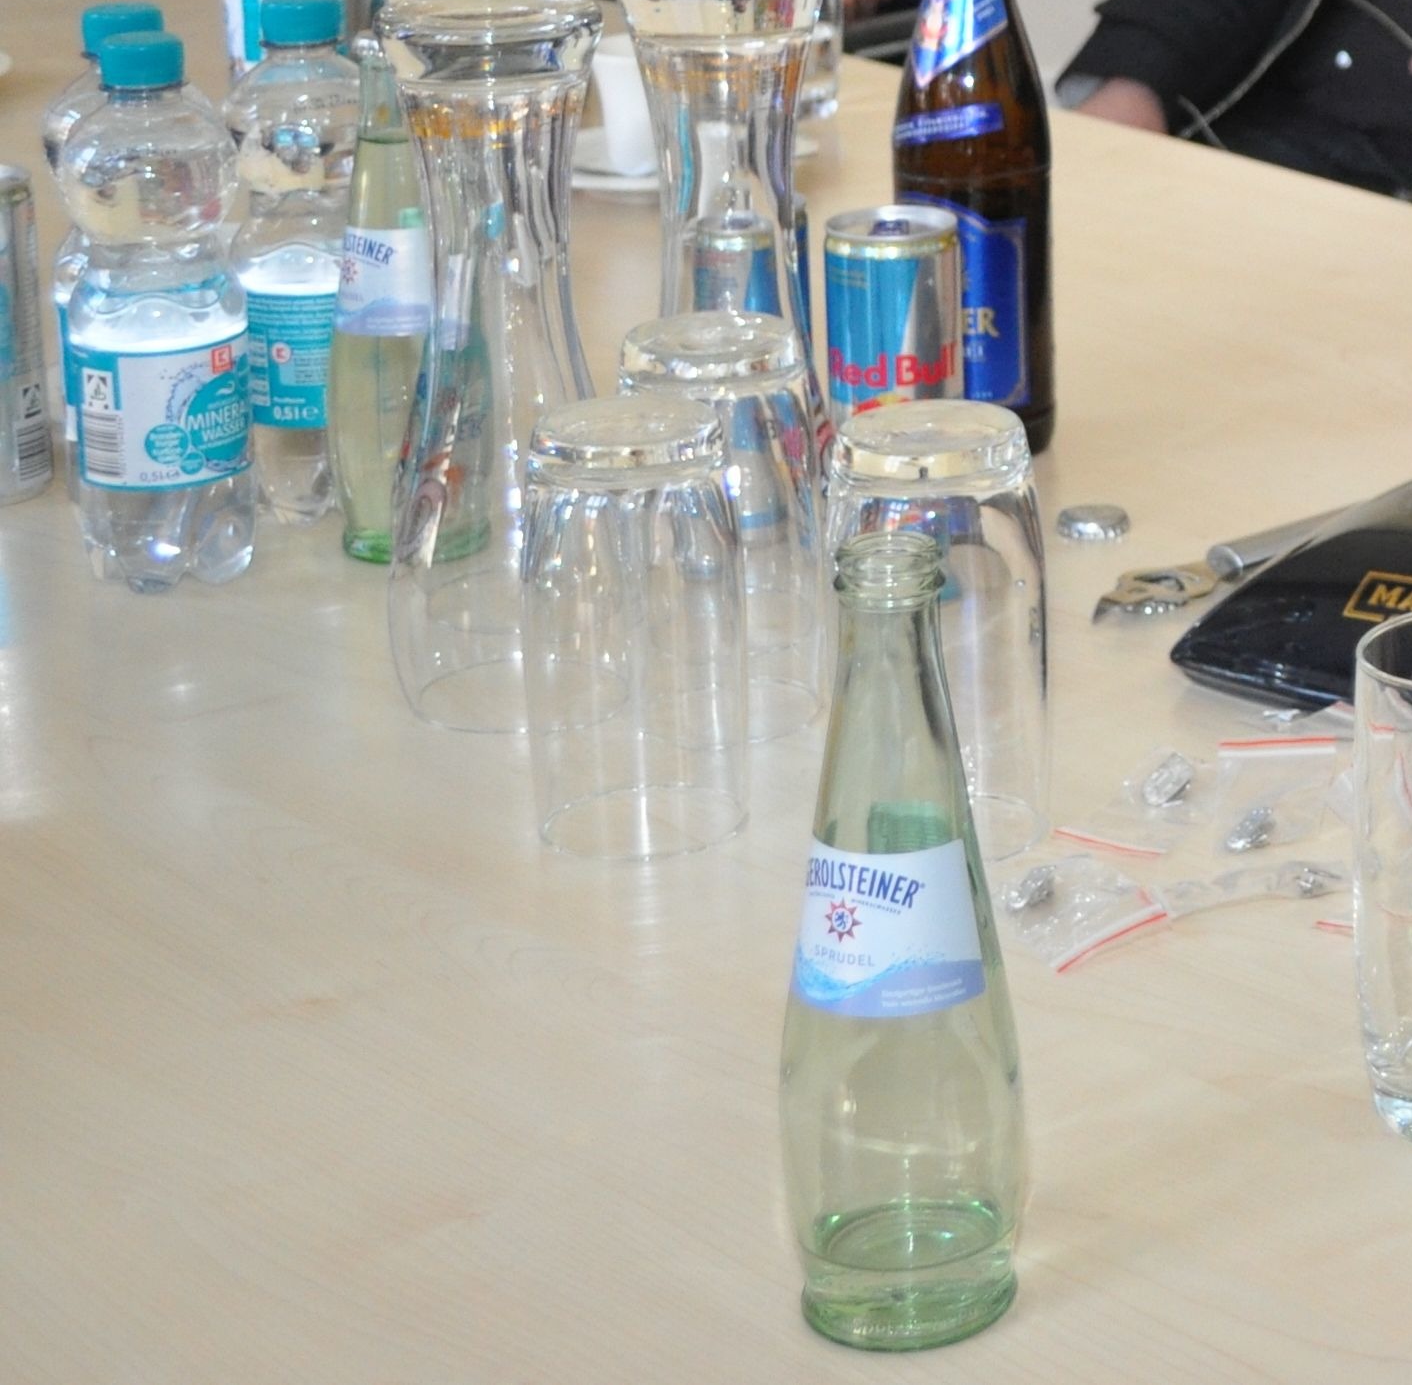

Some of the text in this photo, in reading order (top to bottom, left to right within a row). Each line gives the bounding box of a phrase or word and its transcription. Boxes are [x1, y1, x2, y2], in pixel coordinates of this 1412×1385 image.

[829, 341, 957, 387] Red Bull
[814, 944, 875, 968] SPRUDEL
